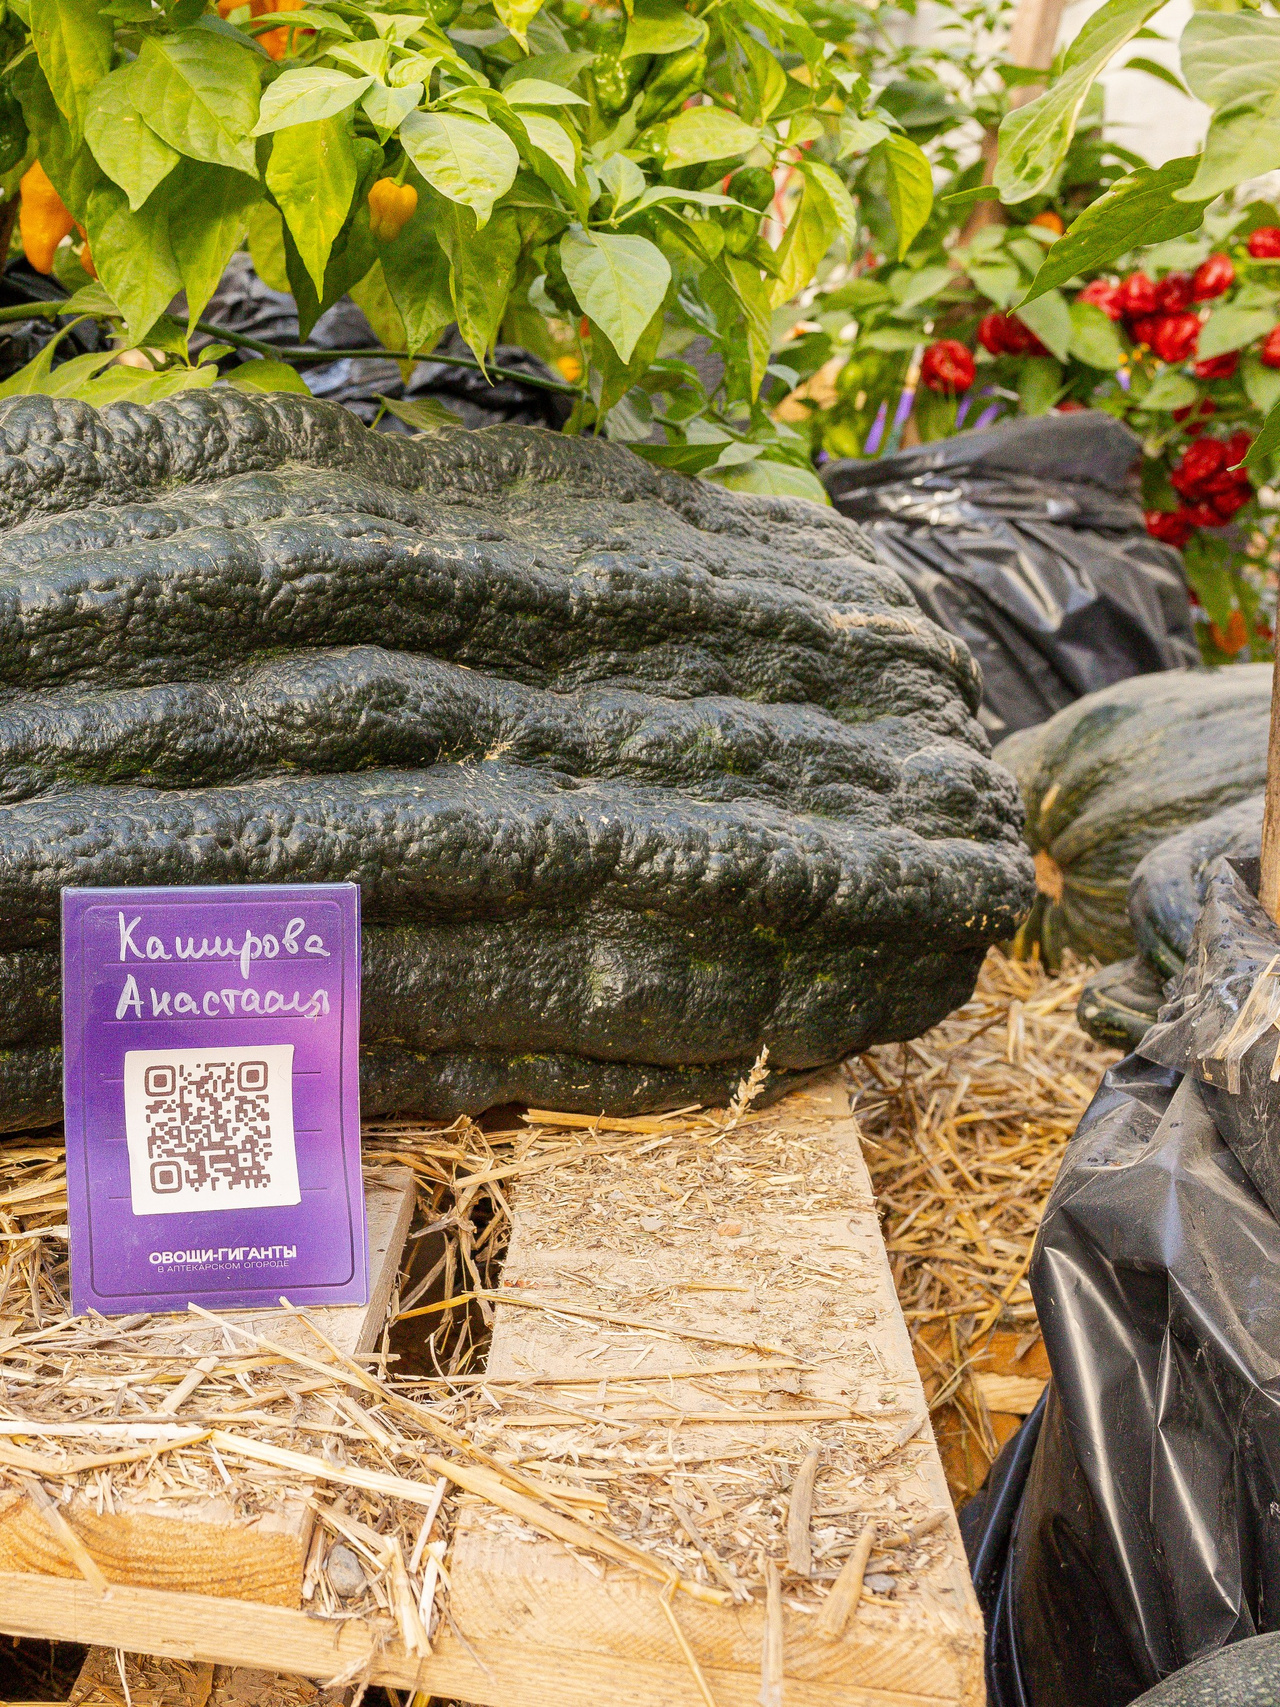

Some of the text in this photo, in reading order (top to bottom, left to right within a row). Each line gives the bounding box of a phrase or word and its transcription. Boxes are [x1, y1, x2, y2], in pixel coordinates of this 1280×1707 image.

[118, 911, 331, 979] Каширова
[148, 1245, 297, 1265] ОВОЩИ-ГИГАНТЫ
[157, 1260, 290, 1273] В АПТЕКАРСКОМ ОГОРОДЕ
